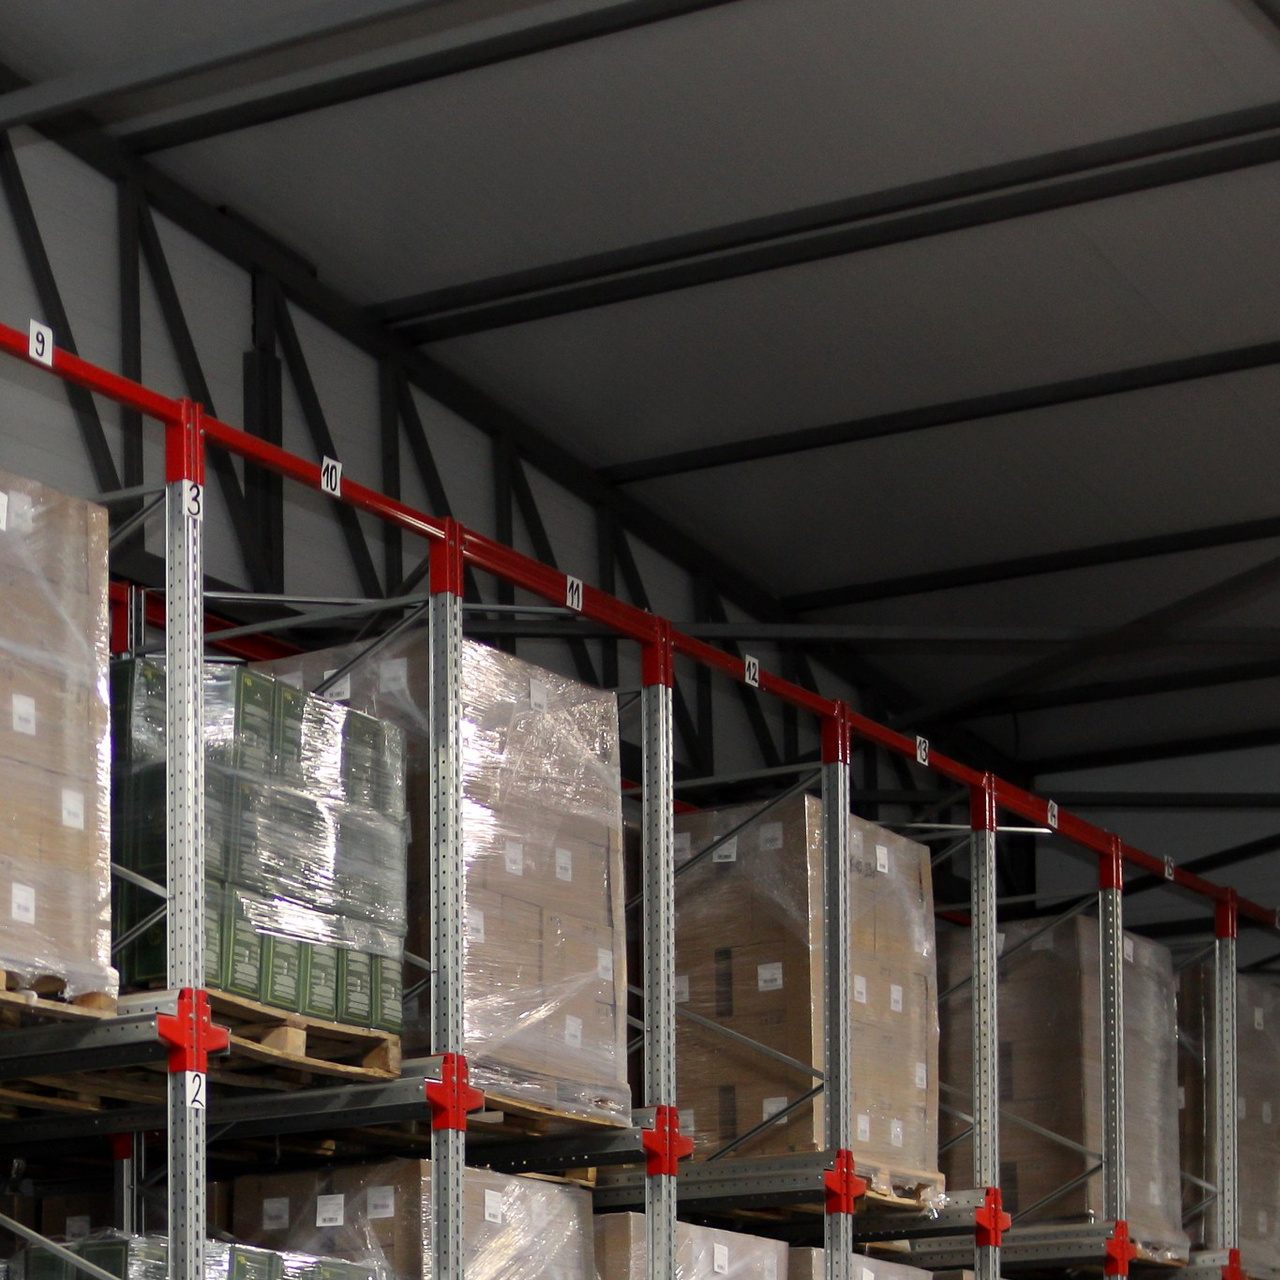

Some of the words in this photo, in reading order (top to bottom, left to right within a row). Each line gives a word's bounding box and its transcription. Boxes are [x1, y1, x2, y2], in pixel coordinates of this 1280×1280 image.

[35, 331, 45, 357] 9
[322, 462, 338, 492] 10
[187, 484, 200, 515] 3
[568, 580, 580, 608] 11
[746, 660, 758, 683] 12
[917, 739, 928, 763] 13
[191, 1073, 204, 1107] 2
